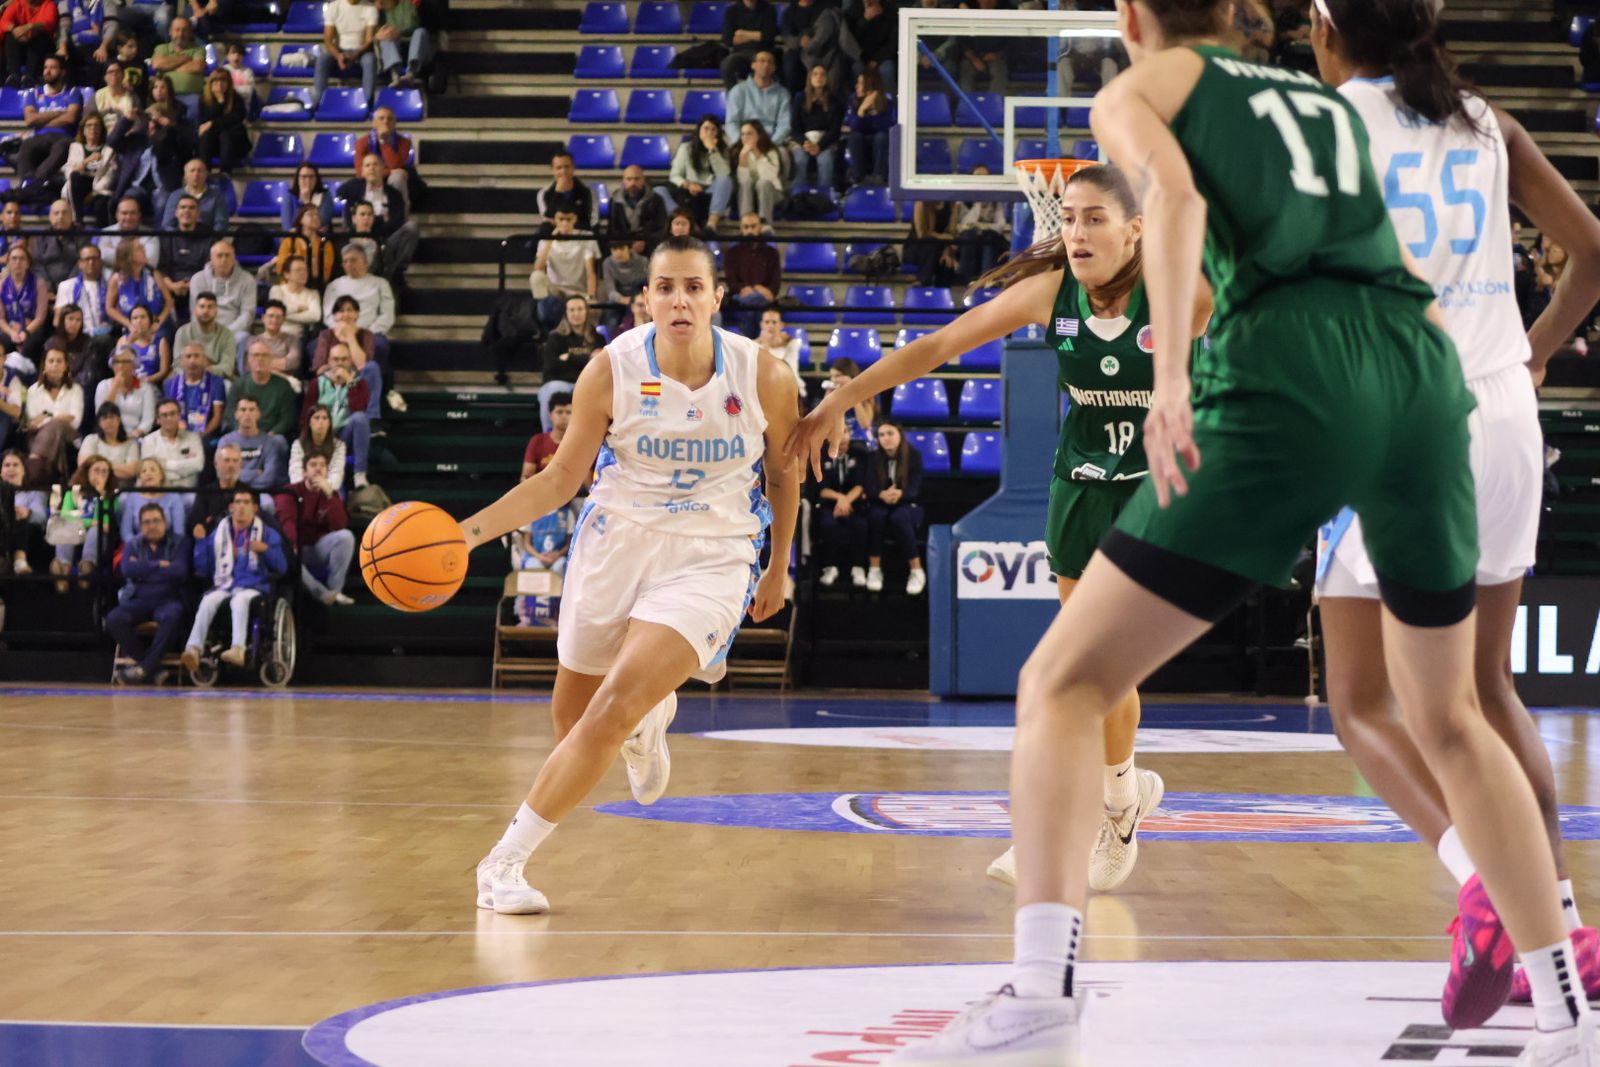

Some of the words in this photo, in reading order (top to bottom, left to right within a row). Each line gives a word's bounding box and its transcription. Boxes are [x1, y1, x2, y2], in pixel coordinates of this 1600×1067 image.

[1248, 87, 1360, 197] 17
[1384, 149, 1486, 258] 55
[637, 434, 746, 463] AVENIDA
[1104, 421, 1135, 456] 18
[543, 535, 554, 552] 6
[962, 550, 1058, 591] Oyr
